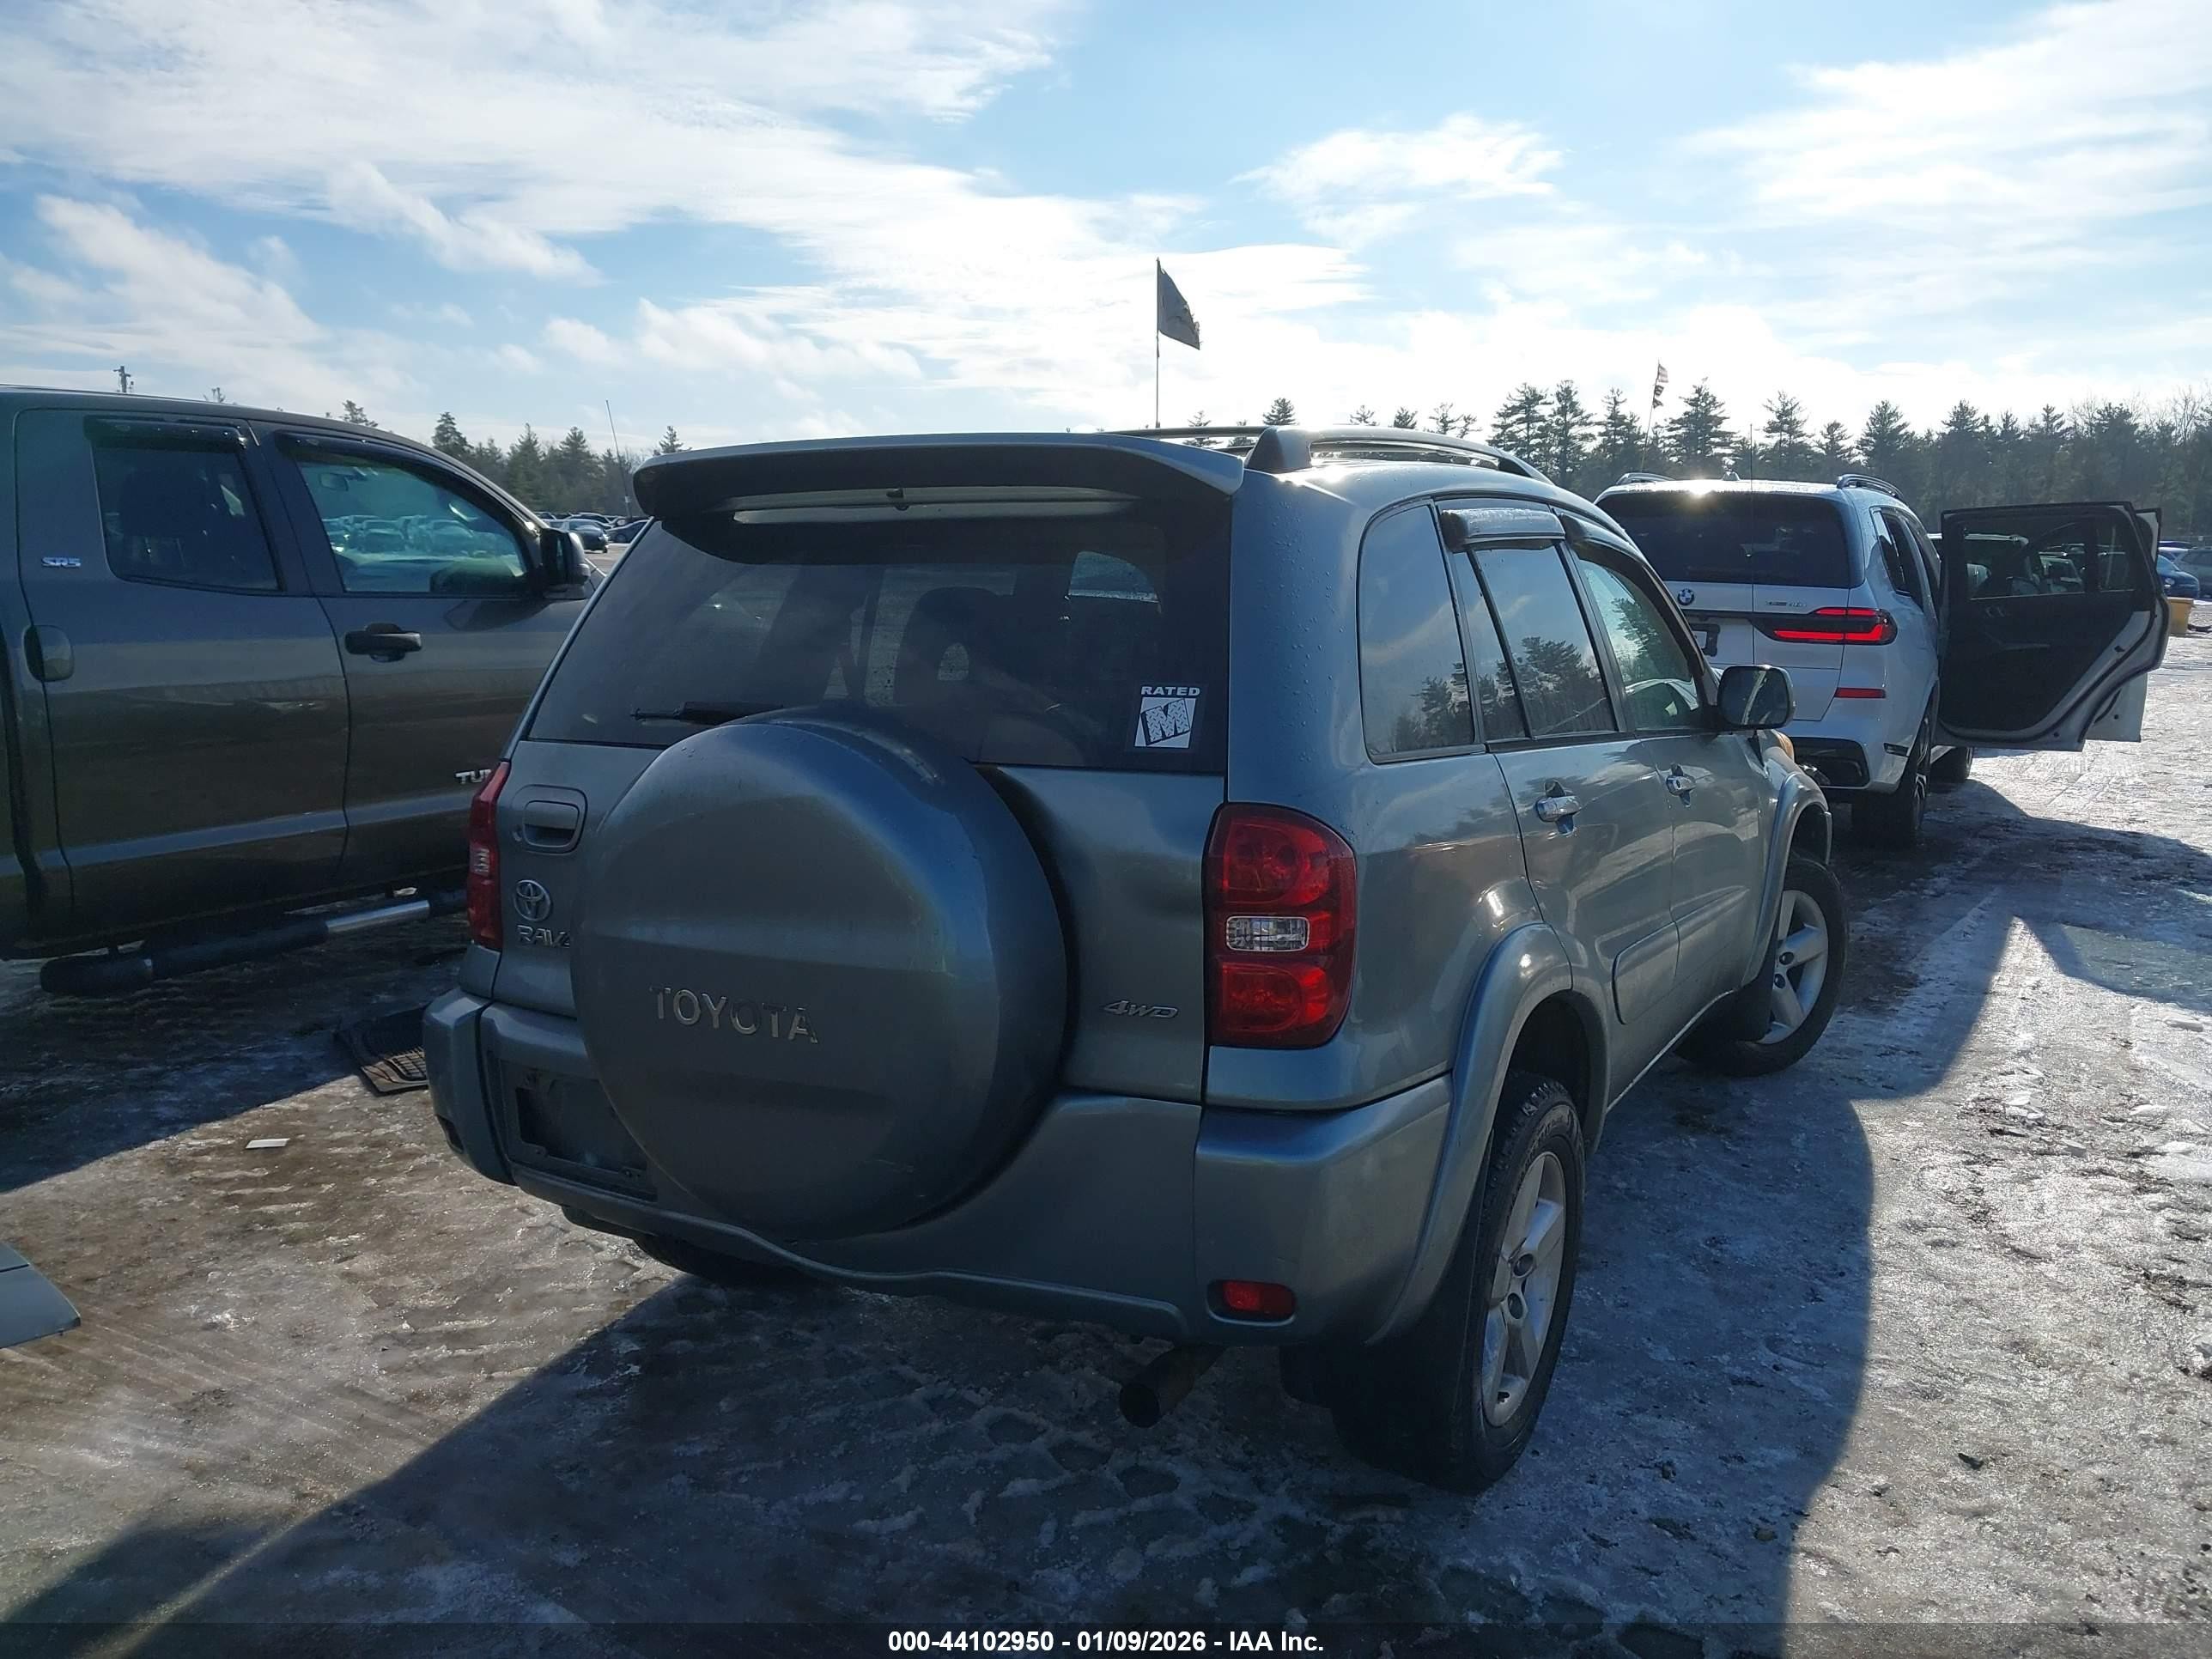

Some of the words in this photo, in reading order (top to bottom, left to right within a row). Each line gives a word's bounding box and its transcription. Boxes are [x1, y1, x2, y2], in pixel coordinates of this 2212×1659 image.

[1140, 686, 1200, 696] RATED
[1140, 698, 1191, 745] M
[649, 987, 818, 1044] TOYOTA
[1103, 1000, 1178, 1018] 4WD
